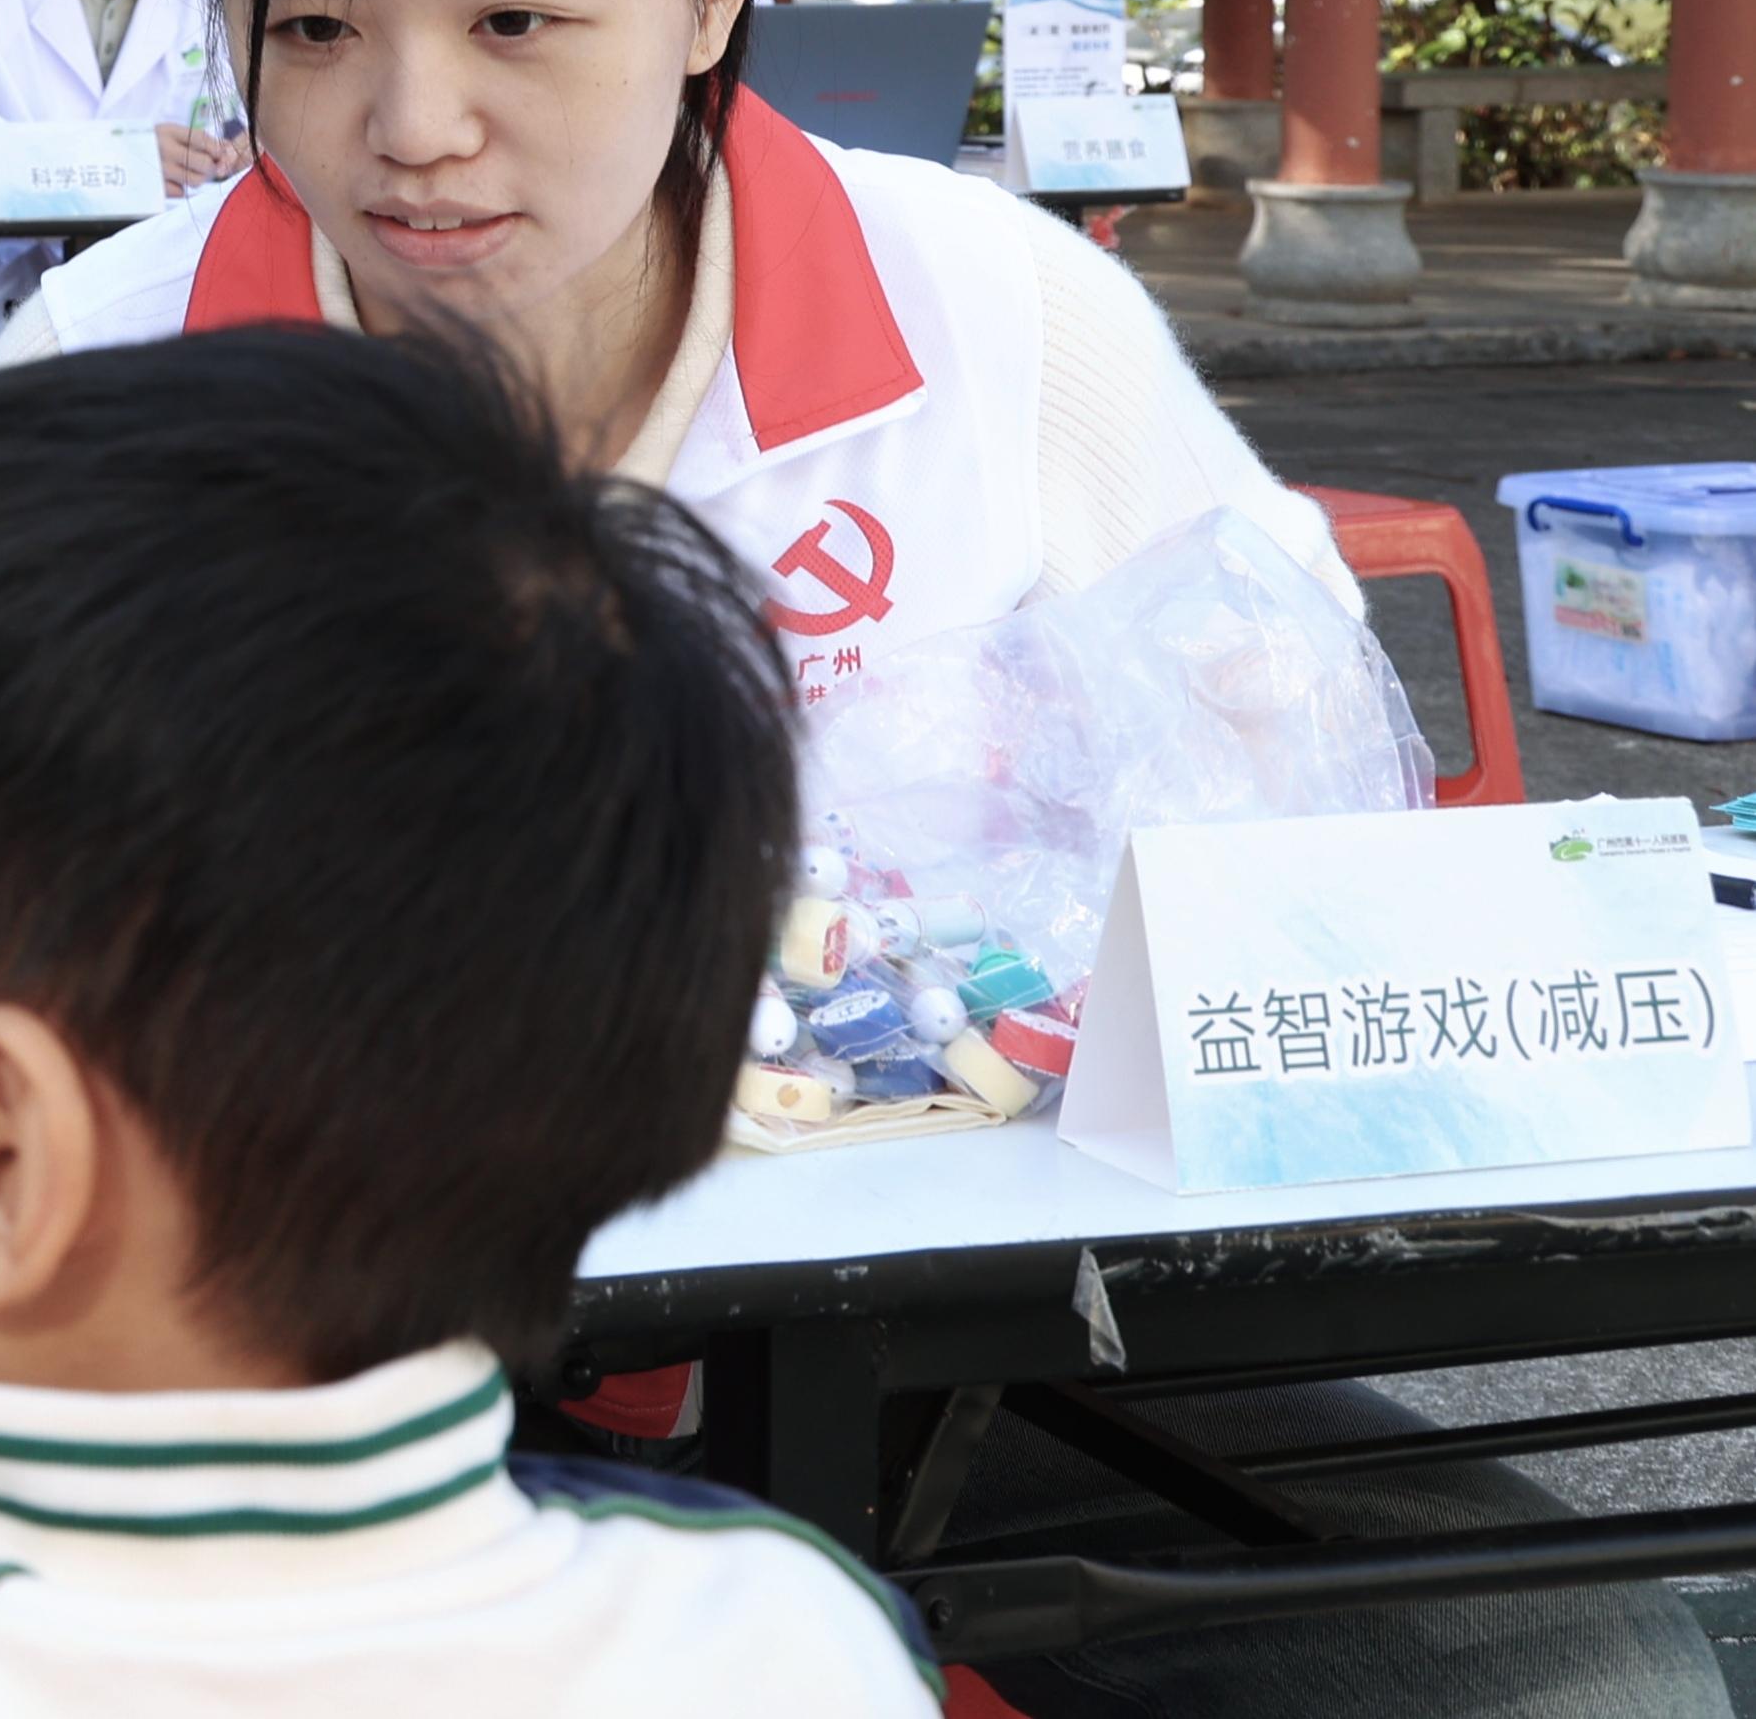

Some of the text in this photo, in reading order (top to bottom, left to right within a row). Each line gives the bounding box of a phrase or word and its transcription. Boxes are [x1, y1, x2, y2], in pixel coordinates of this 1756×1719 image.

[1062, 137, 1148, 161] 营养膳食
[29, 164, 128, 188] 科学运动
[797, 646, 862, 682] 广州
[1186, 965, 1719, 1078] 益智游戏(减压)
